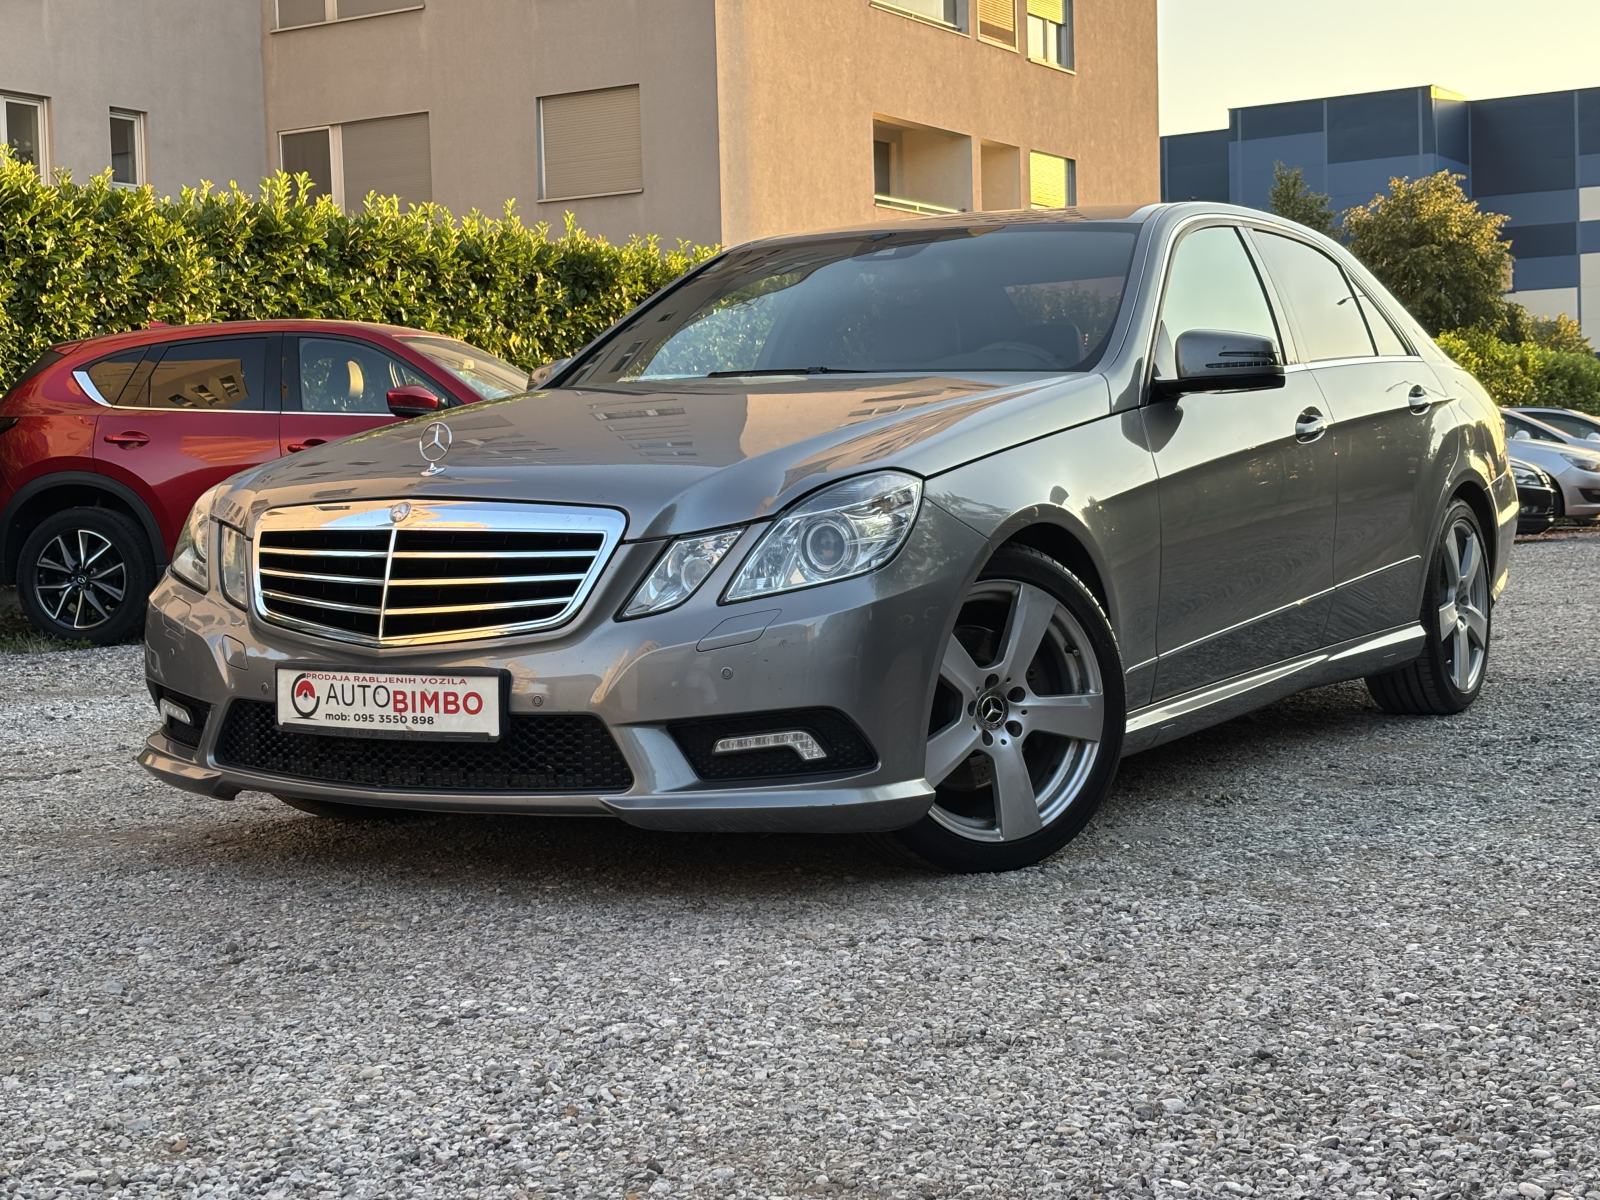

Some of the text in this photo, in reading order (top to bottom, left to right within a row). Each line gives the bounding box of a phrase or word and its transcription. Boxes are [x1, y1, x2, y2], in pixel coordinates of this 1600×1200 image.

[306, 672, 350, 682] PRODAJA
[353, 675, 416, 685] RABLJENIH
[325, 713, 434, 725] mob: 095 3550 898
